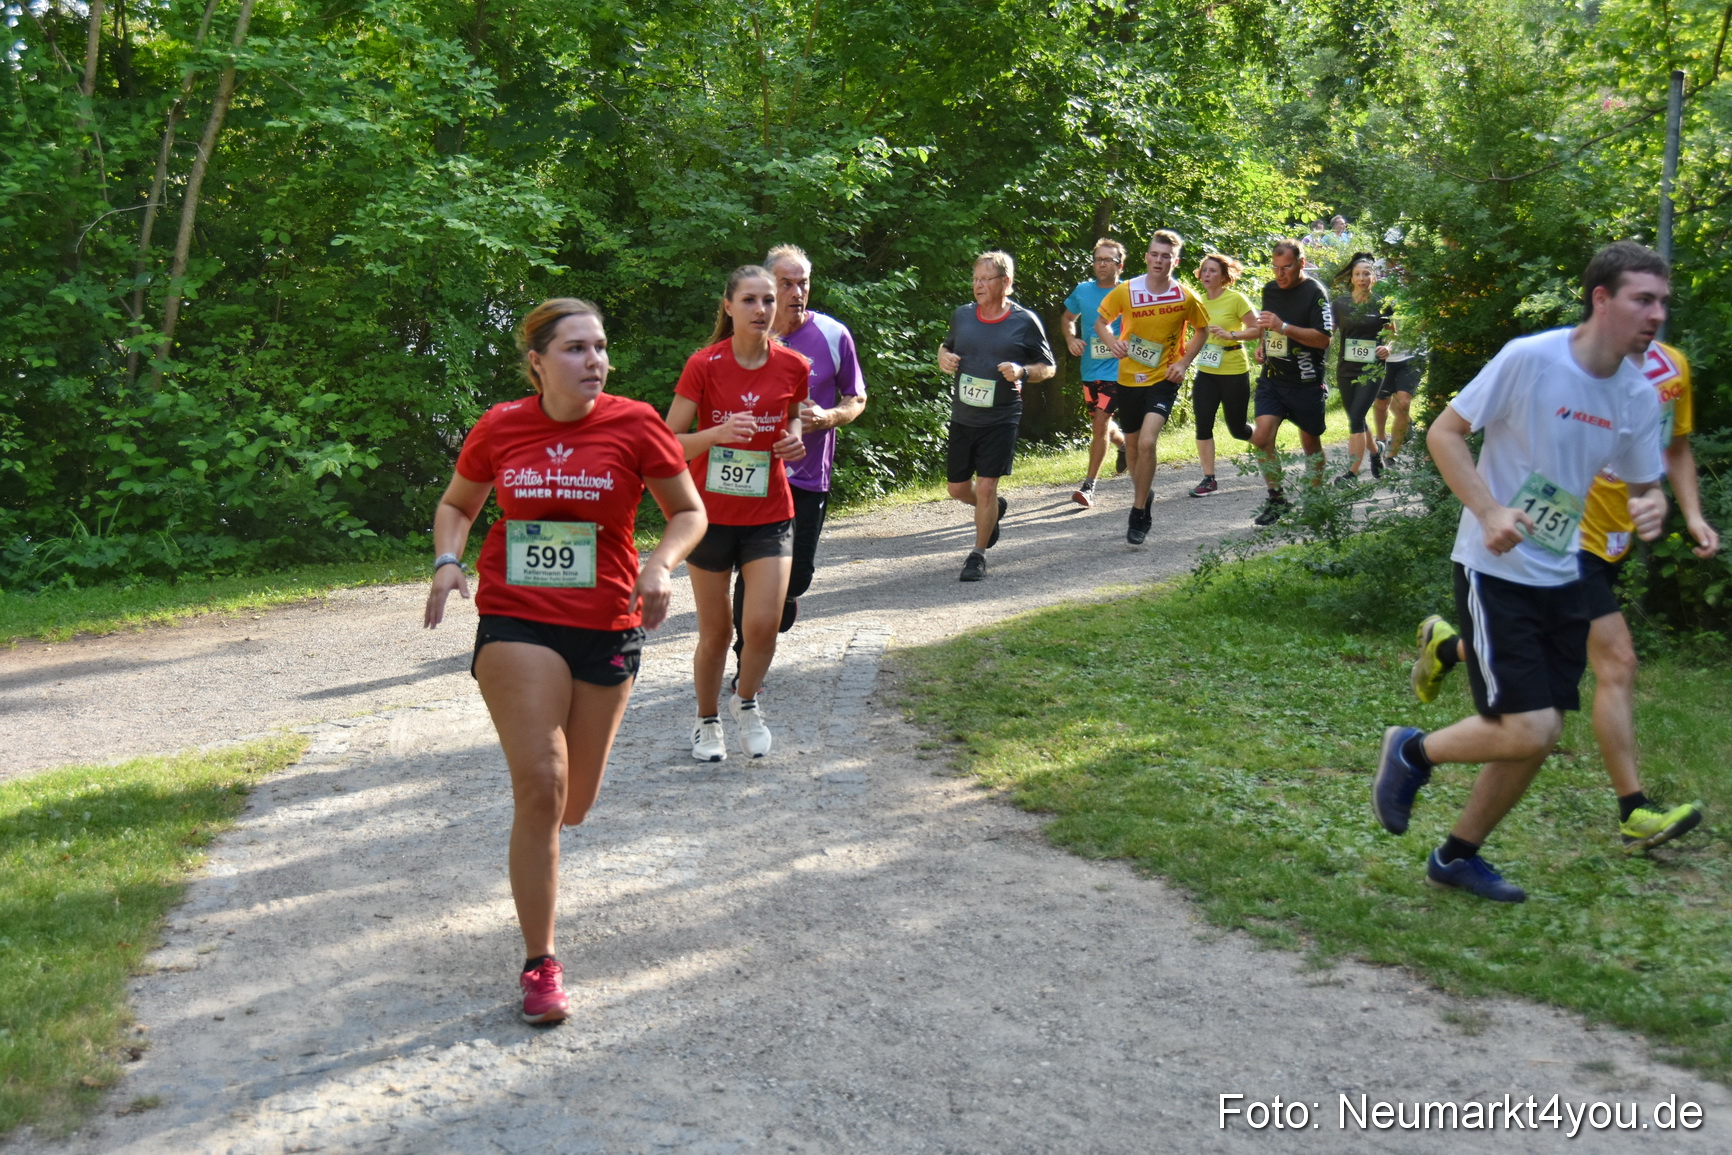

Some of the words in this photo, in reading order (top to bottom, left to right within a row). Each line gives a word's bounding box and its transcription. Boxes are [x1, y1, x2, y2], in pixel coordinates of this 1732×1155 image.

[1132, 310, 1155, 319] MAX
[1158, 304, 1186, 315] BÖGL
[1131, 344, 1156, 360] 1567
[1352, 347, 1369, 357] 169
[963, 385, 988, 399] 1477
[504, 468, 543, 488] Echtes
[545, 468, 614, 491] Handwerk
[720, 465, 756, 484] 597
[515, 488, 552, 499] IMMER
[556, 489, 600, 501] FRISCH
[1523, 498, 1570, 537] 1151
[526, 545, 575, 569] 599
